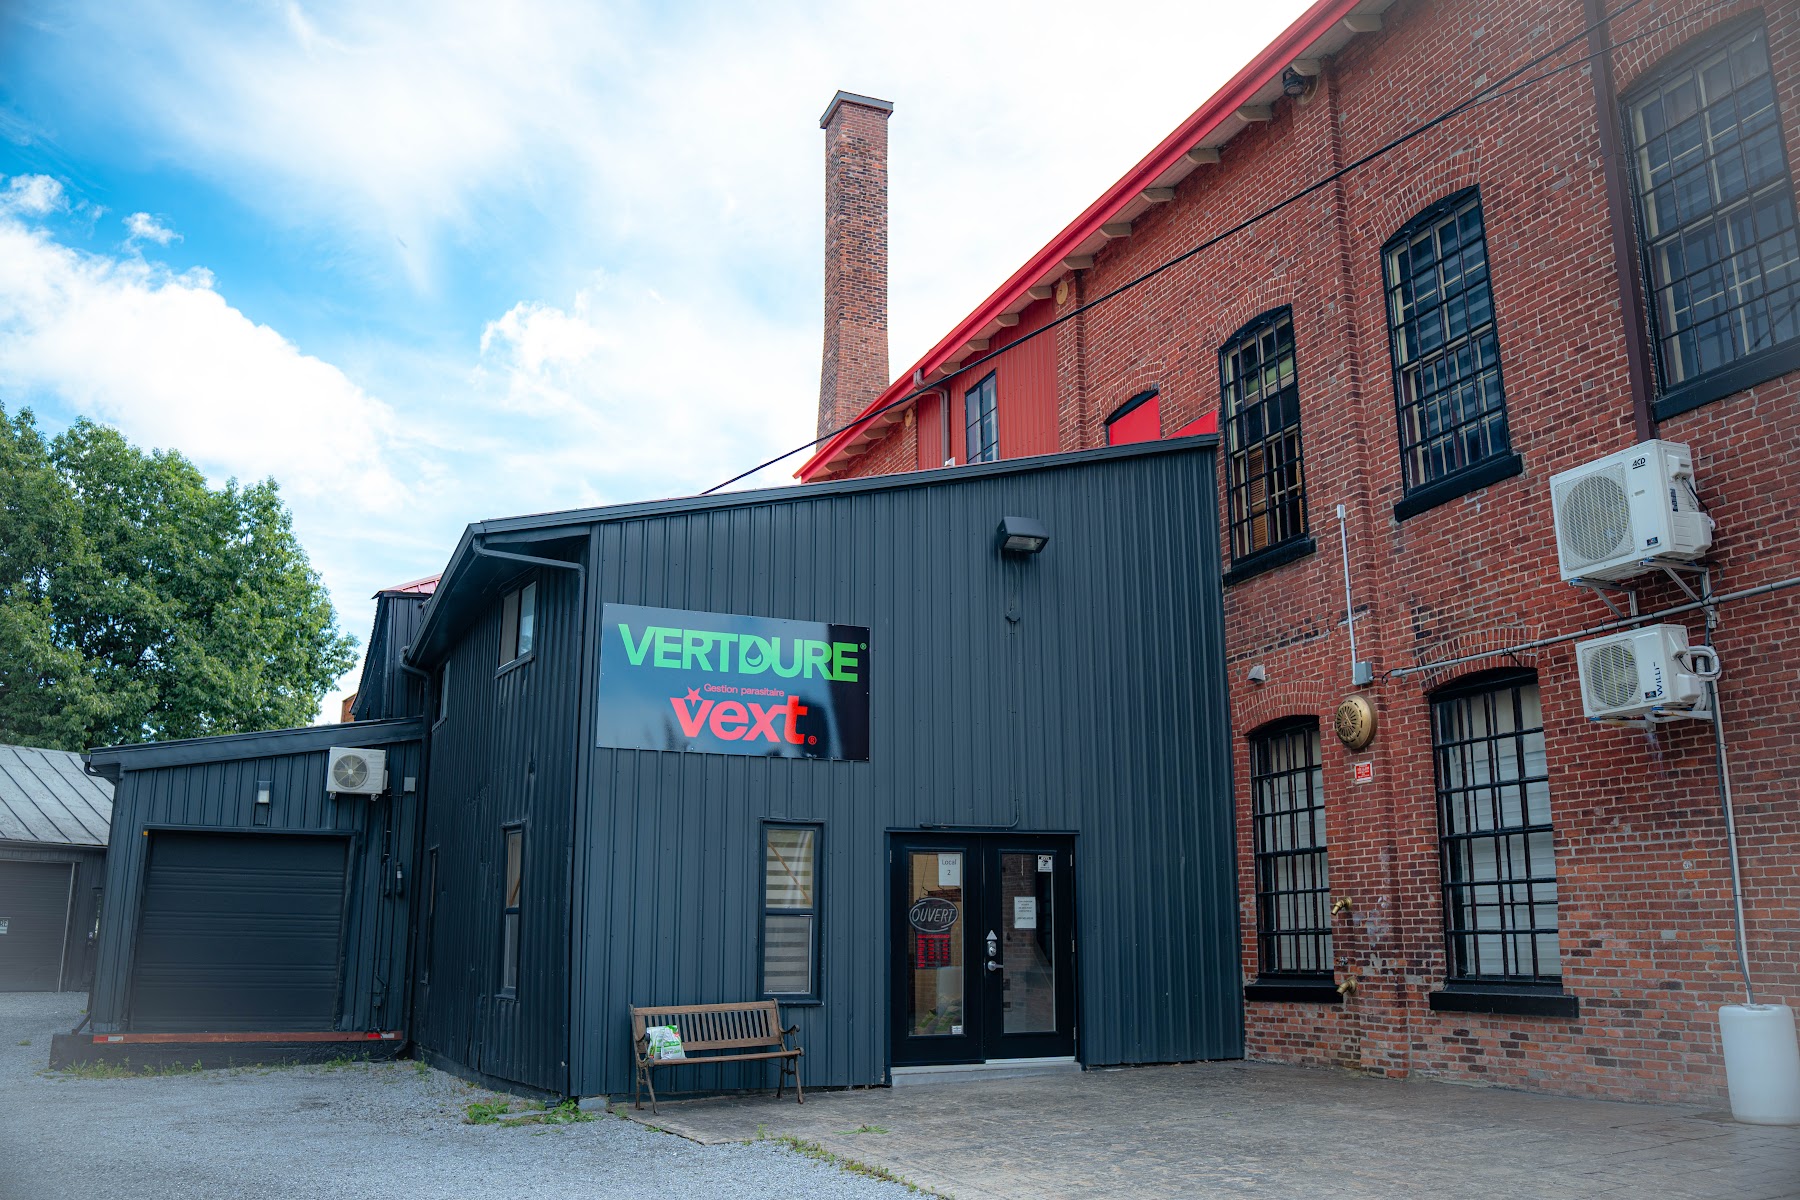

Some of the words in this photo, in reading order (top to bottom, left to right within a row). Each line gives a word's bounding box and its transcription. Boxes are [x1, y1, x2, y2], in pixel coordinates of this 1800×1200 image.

[703, 683, 738, 694] Gestion
[740, 686, 785, 698] parasitaire
[669, 695, 808, 745] vext
[941, 858, 957, 866] Local
[911, 908, 955, 923] OUVERT
